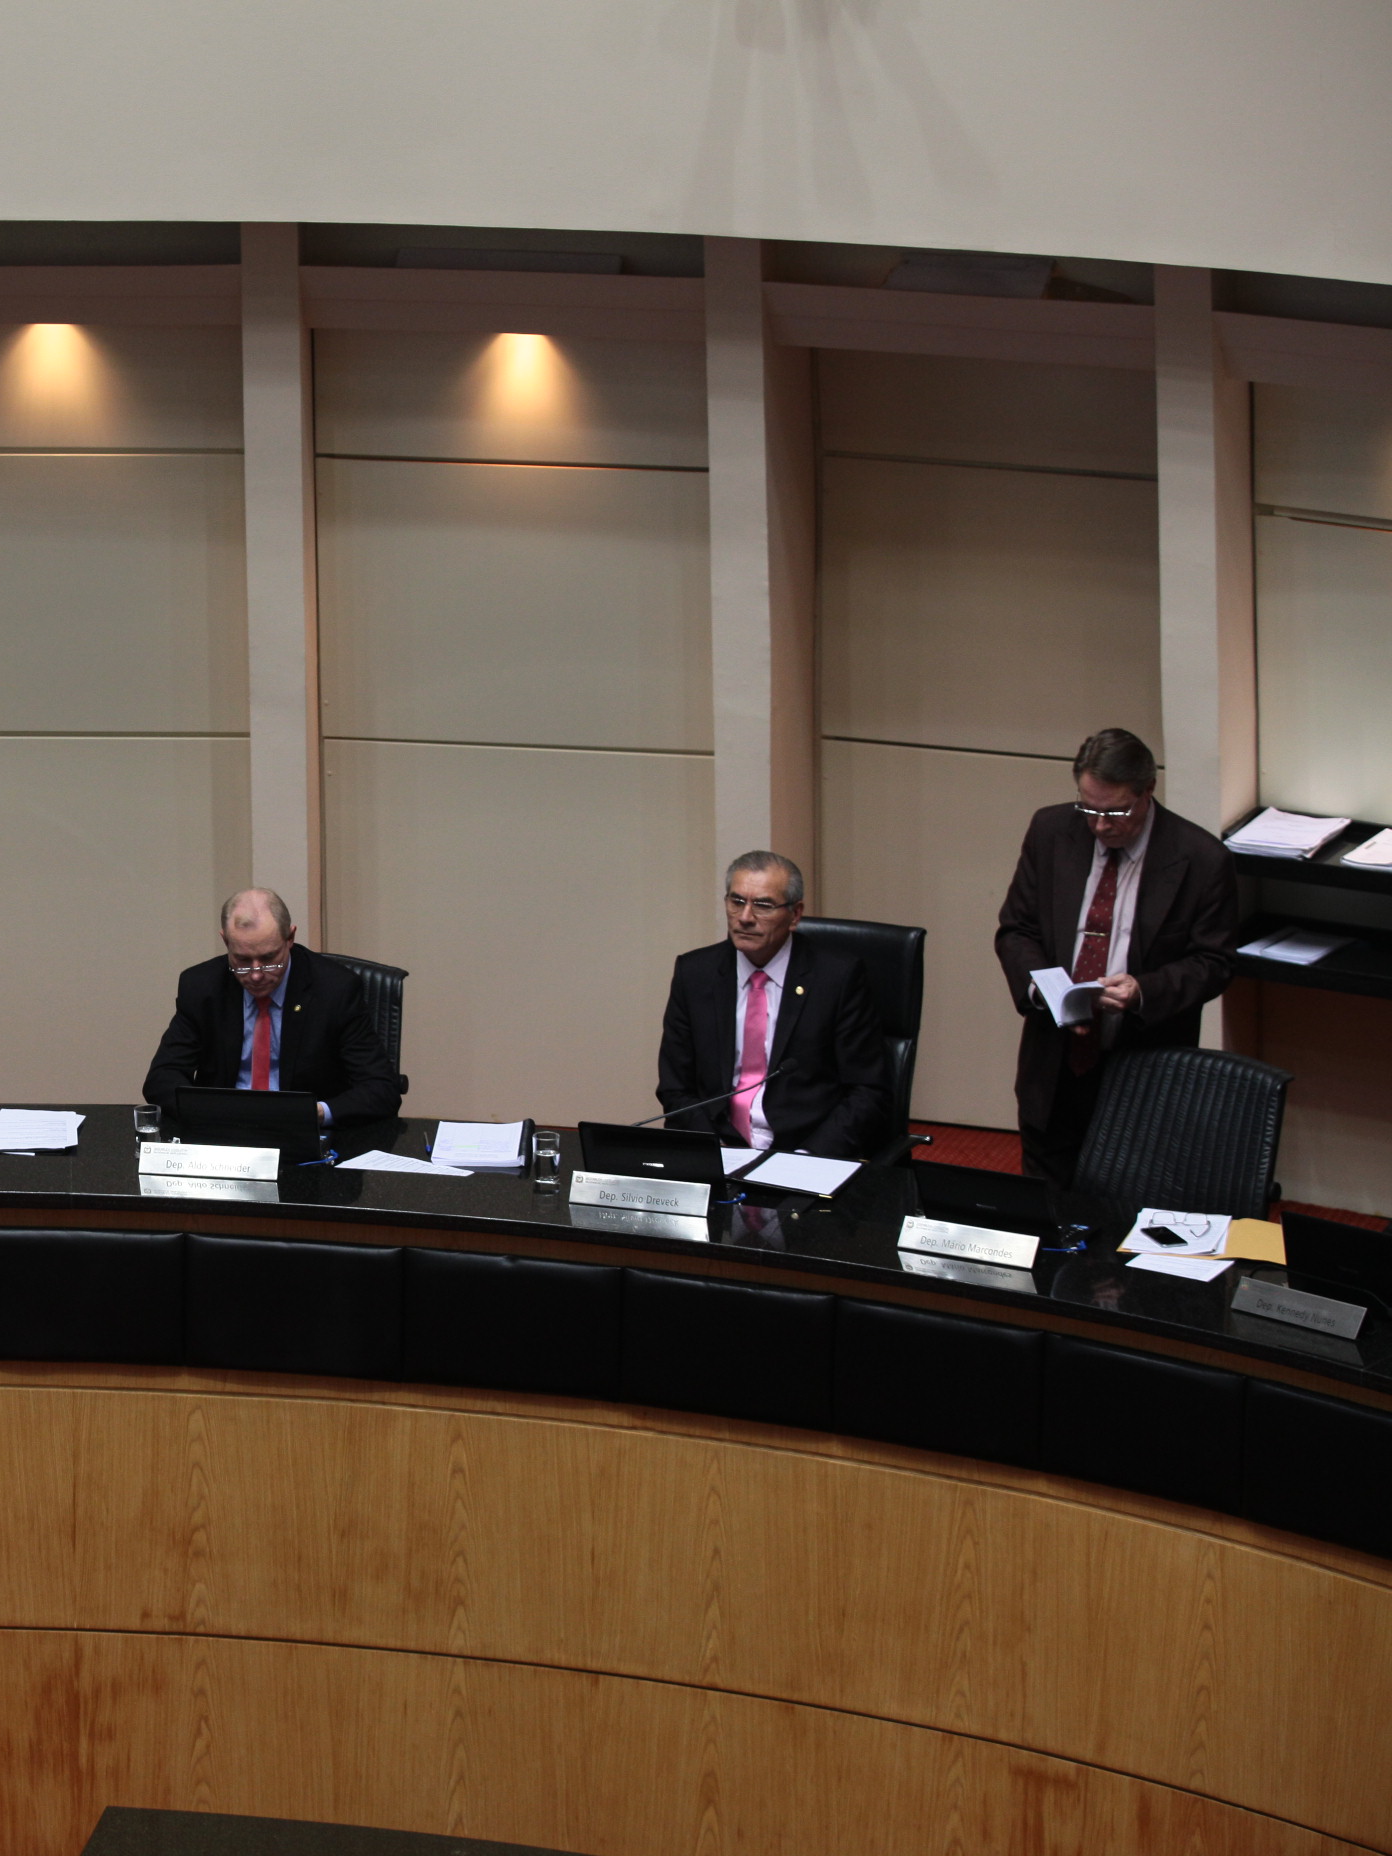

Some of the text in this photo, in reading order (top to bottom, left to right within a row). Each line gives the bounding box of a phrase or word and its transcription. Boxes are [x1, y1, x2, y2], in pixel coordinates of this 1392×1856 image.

[165, 1159, 185, 1172] Dep.
[599, 1190, 680, 1208] Dep. Silvio Dreveck
[919, 1235, 939, 1248] Dep.
[967, 1242, 1014, 1260] Marcondes
[1255, 1297, 1274, 1313] Dep.
[1276, 1303, 1309, 1323] Kennedy
